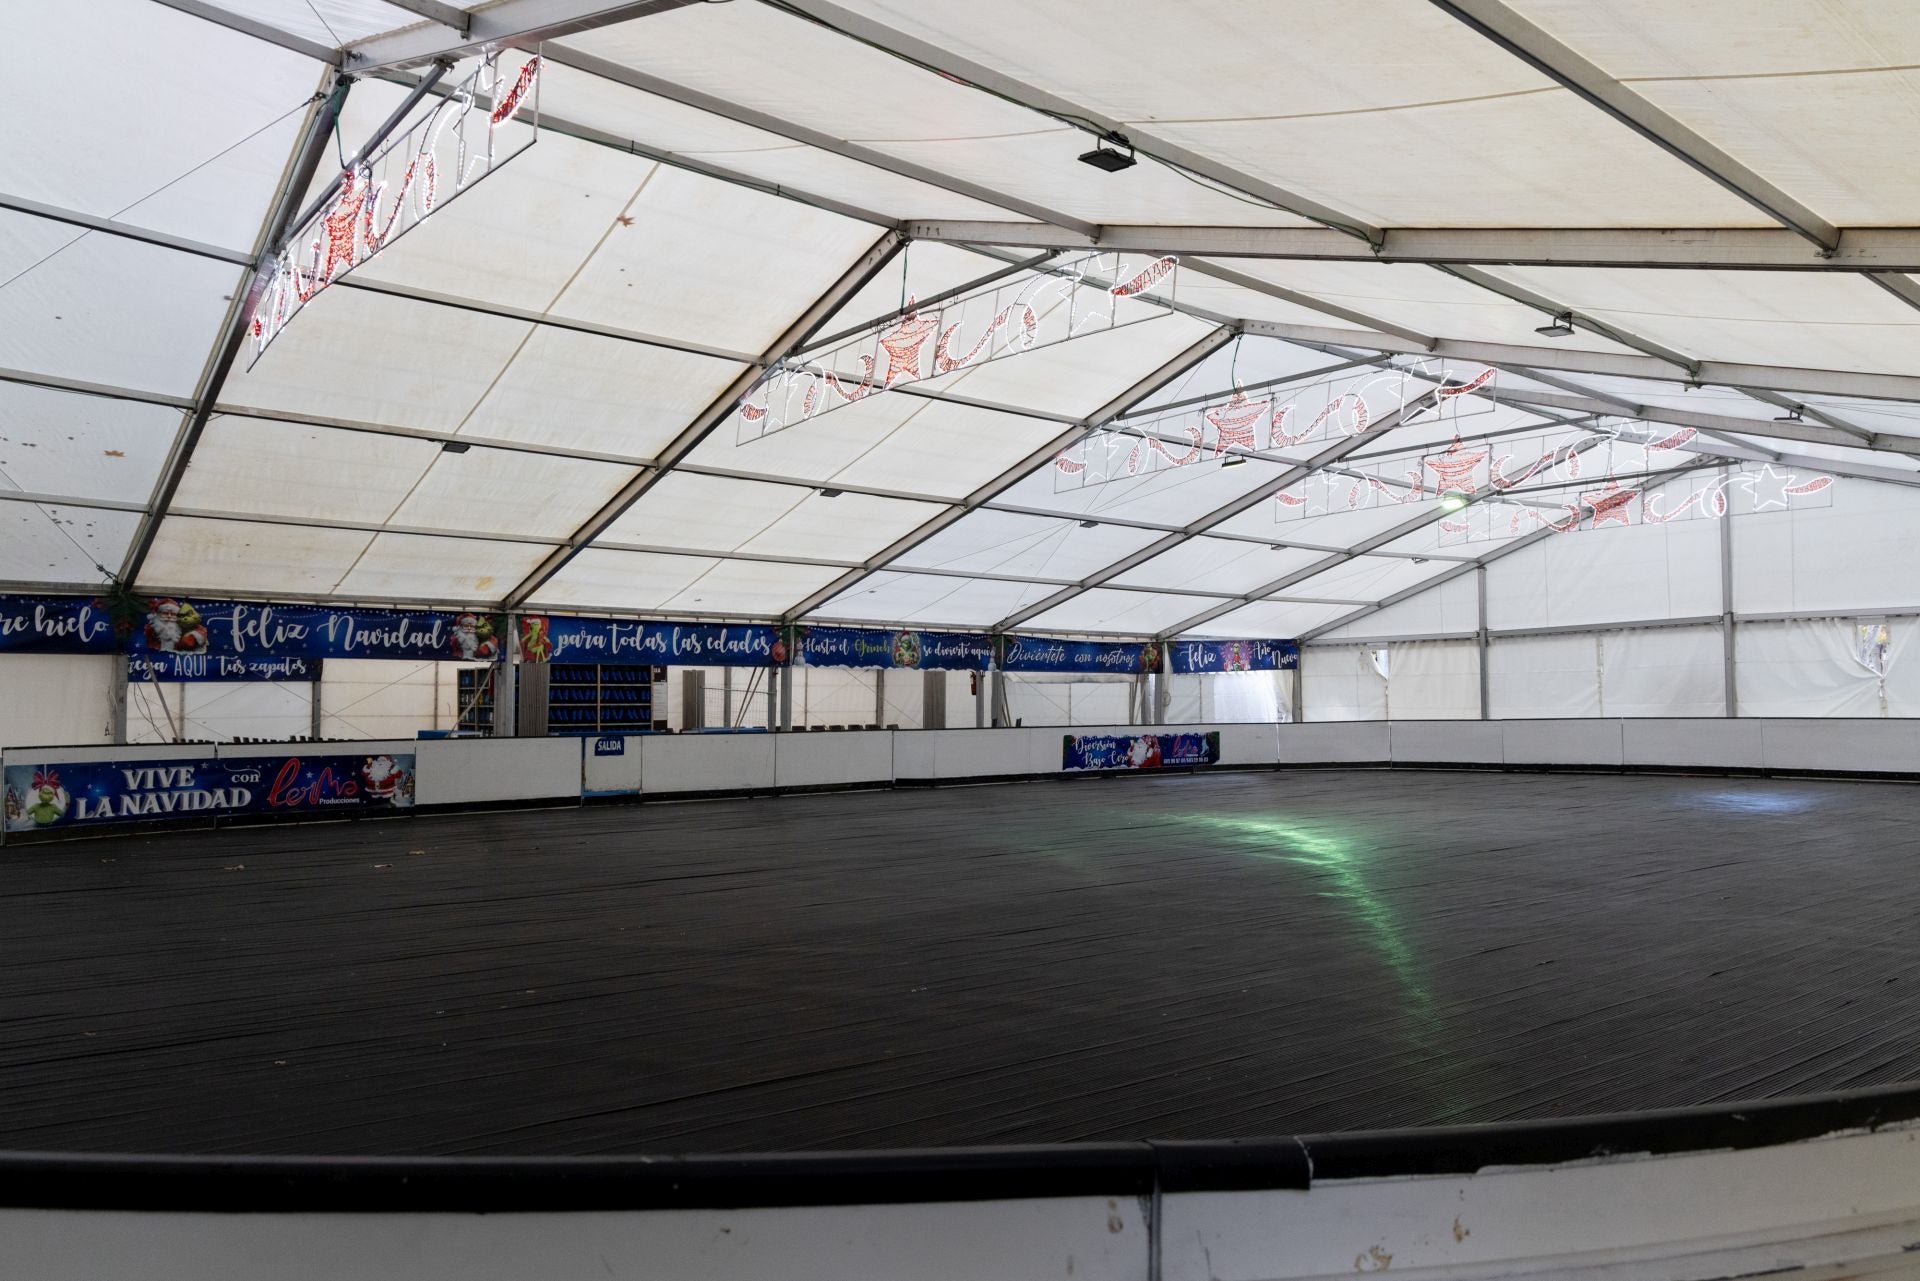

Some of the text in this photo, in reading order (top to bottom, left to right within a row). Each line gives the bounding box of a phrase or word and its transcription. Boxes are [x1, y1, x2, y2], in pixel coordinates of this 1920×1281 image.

[0, 605, 109, 642] re hielo
[317, 615, 446, 651] Navidad
[554, 630, 607, 656] para
[672, 627, 702, 656] las
[707, 628, 771, 656] edades
[803, 637, 837, 655] Hasta
[839, 638, 849, 655] el
[854, 638, 891, 657] Grinch
[923, 644, 932, 656] se
[934, 641, 971, 658] divierte
[1074, 652, 1093, 663] con
[1095, 648, 1135, 667] nosotros
[1252, 641, 1272, 660] Año
[1268, 650, 1298, 668] Nuevo
[249, 656, 307, 679] zapatos
[597, 740, 622, 752] SALIDA
[122, 766, 196, 791] VIVE
[230, 770, 261, 784] con
[74, 787, 252, 820] LA NAVIDAD
[319, 797, 360, 805] Producciones
